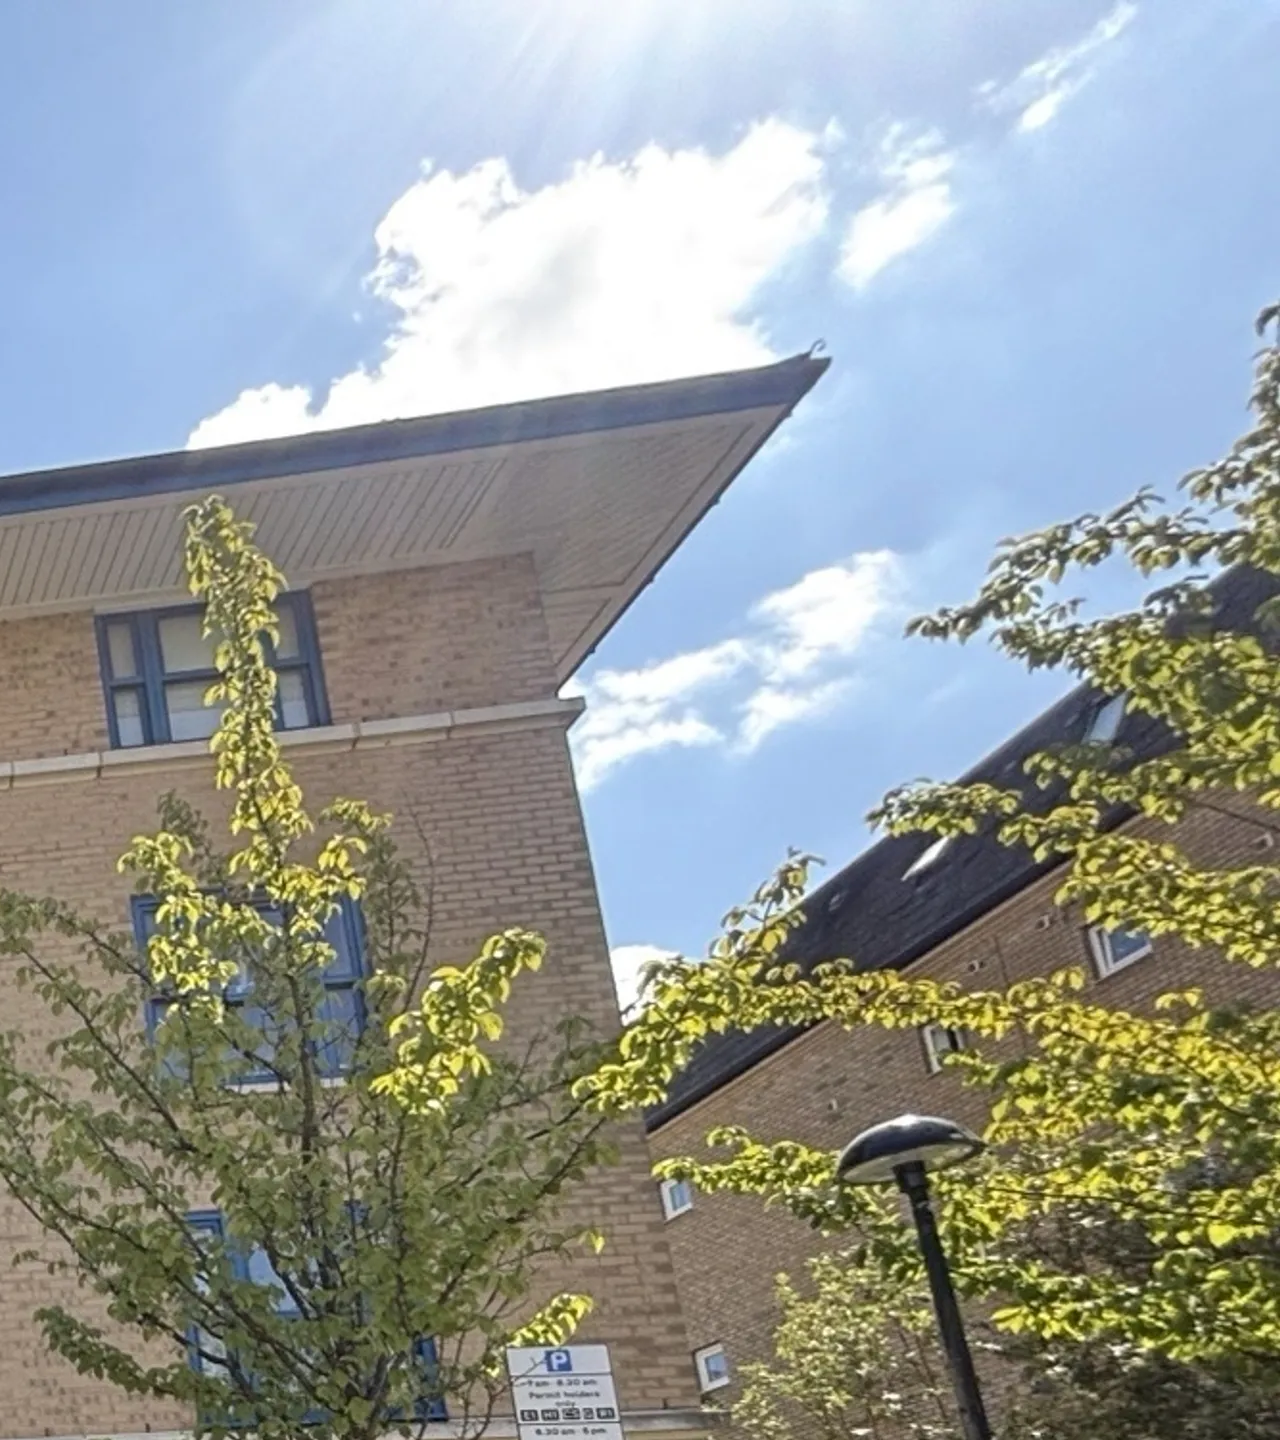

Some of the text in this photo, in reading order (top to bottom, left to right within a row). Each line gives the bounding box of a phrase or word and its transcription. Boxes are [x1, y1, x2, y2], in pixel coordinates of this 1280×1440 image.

[550, 1351, 568, 1370] P
[528, 1390, 600, 1399] Permit holders
[554, 1400, 576, 1408] only
